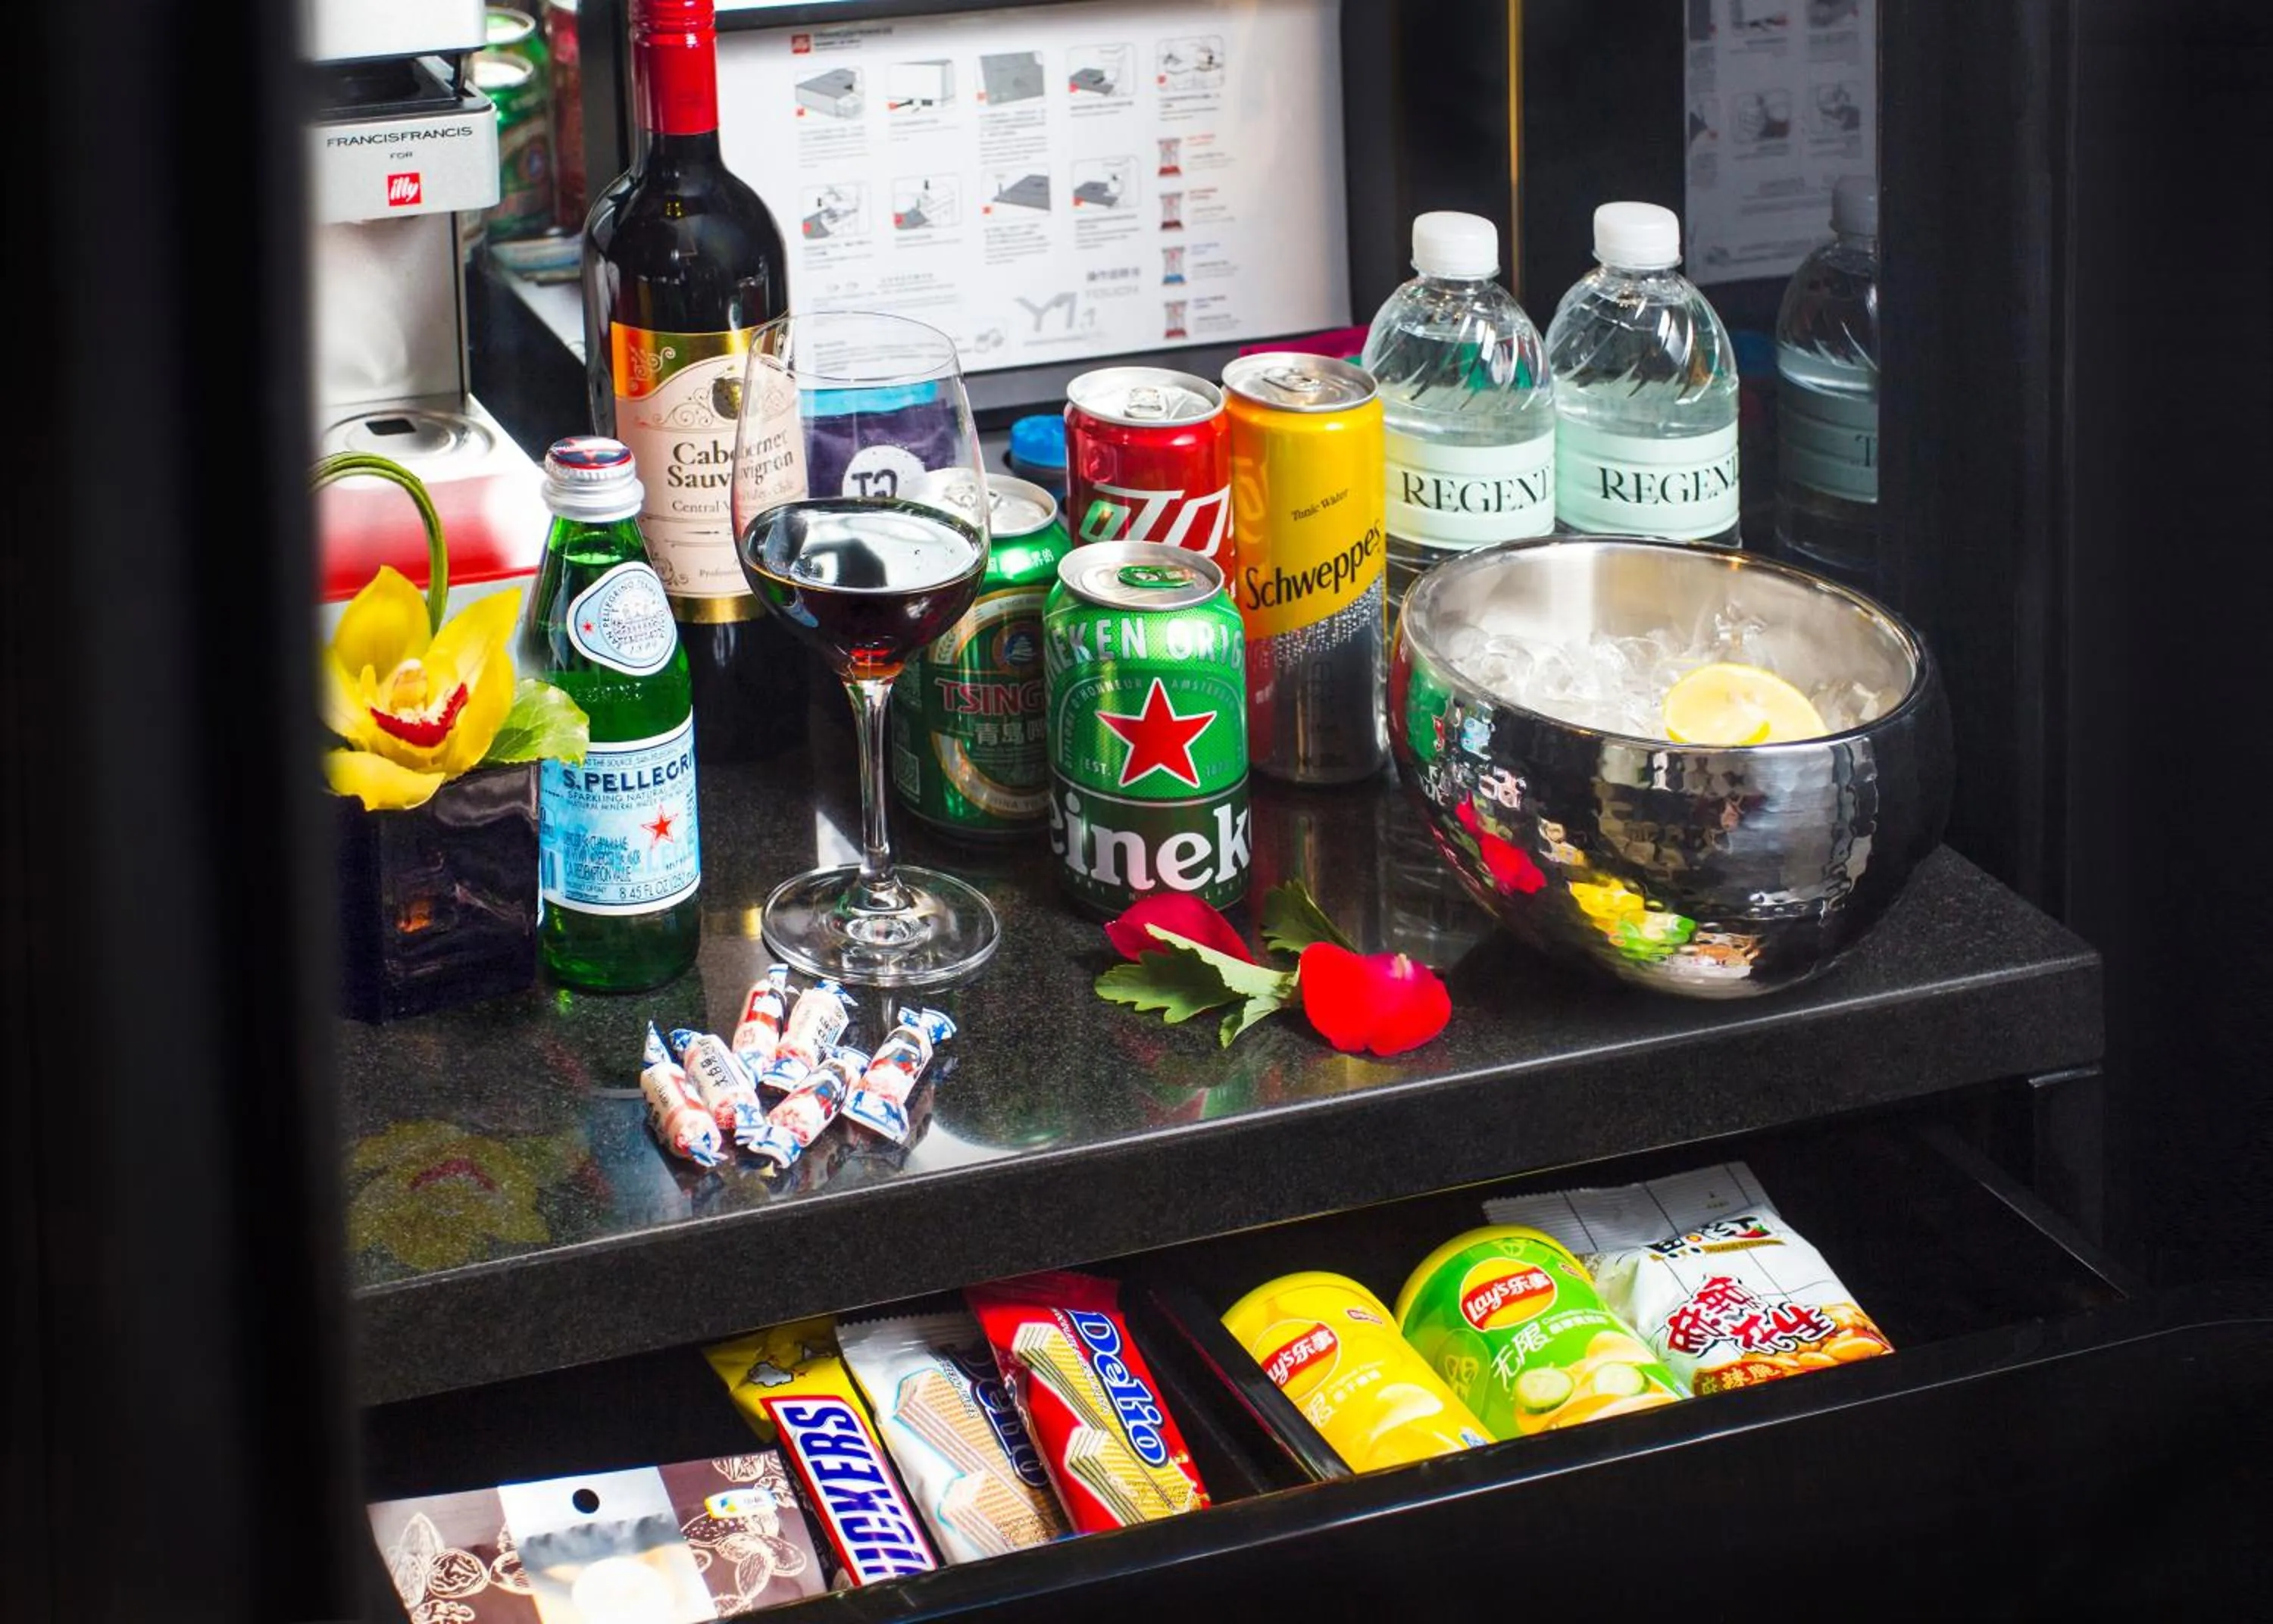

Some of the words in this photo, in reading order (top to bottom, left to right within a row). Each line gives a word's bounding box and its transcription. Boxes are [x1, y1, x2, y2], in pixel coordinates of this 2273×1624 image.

[327, 126, 474, 147] FRANCISFRANCIS
[390, 176, 420, 202] illy
[1402, 464, 1549, 513] REGEN
[1599, 456, 1738, 505] REGEN
[672, 499, 720, 513] Central
[1292, 504, 1320, 521] Tonic
[1321, 489, 1349, 509] Water
[1246, 519, 1381, 611] Schweppes
[1167, 618, 1246, 670] ORIG
[934, 677, 1046, 716] TSING
[562, 747, 693, 793] S.PELLEGRI
[567, 792, 624, 802] SPARKLING
[1049, 792, 1252, 892] inek
[1467, 1282, 1509, 1323] Lay's
[1064, 1309, 1166, 1463] Delio
[783, 1407, 927, 1576] ICKERS
